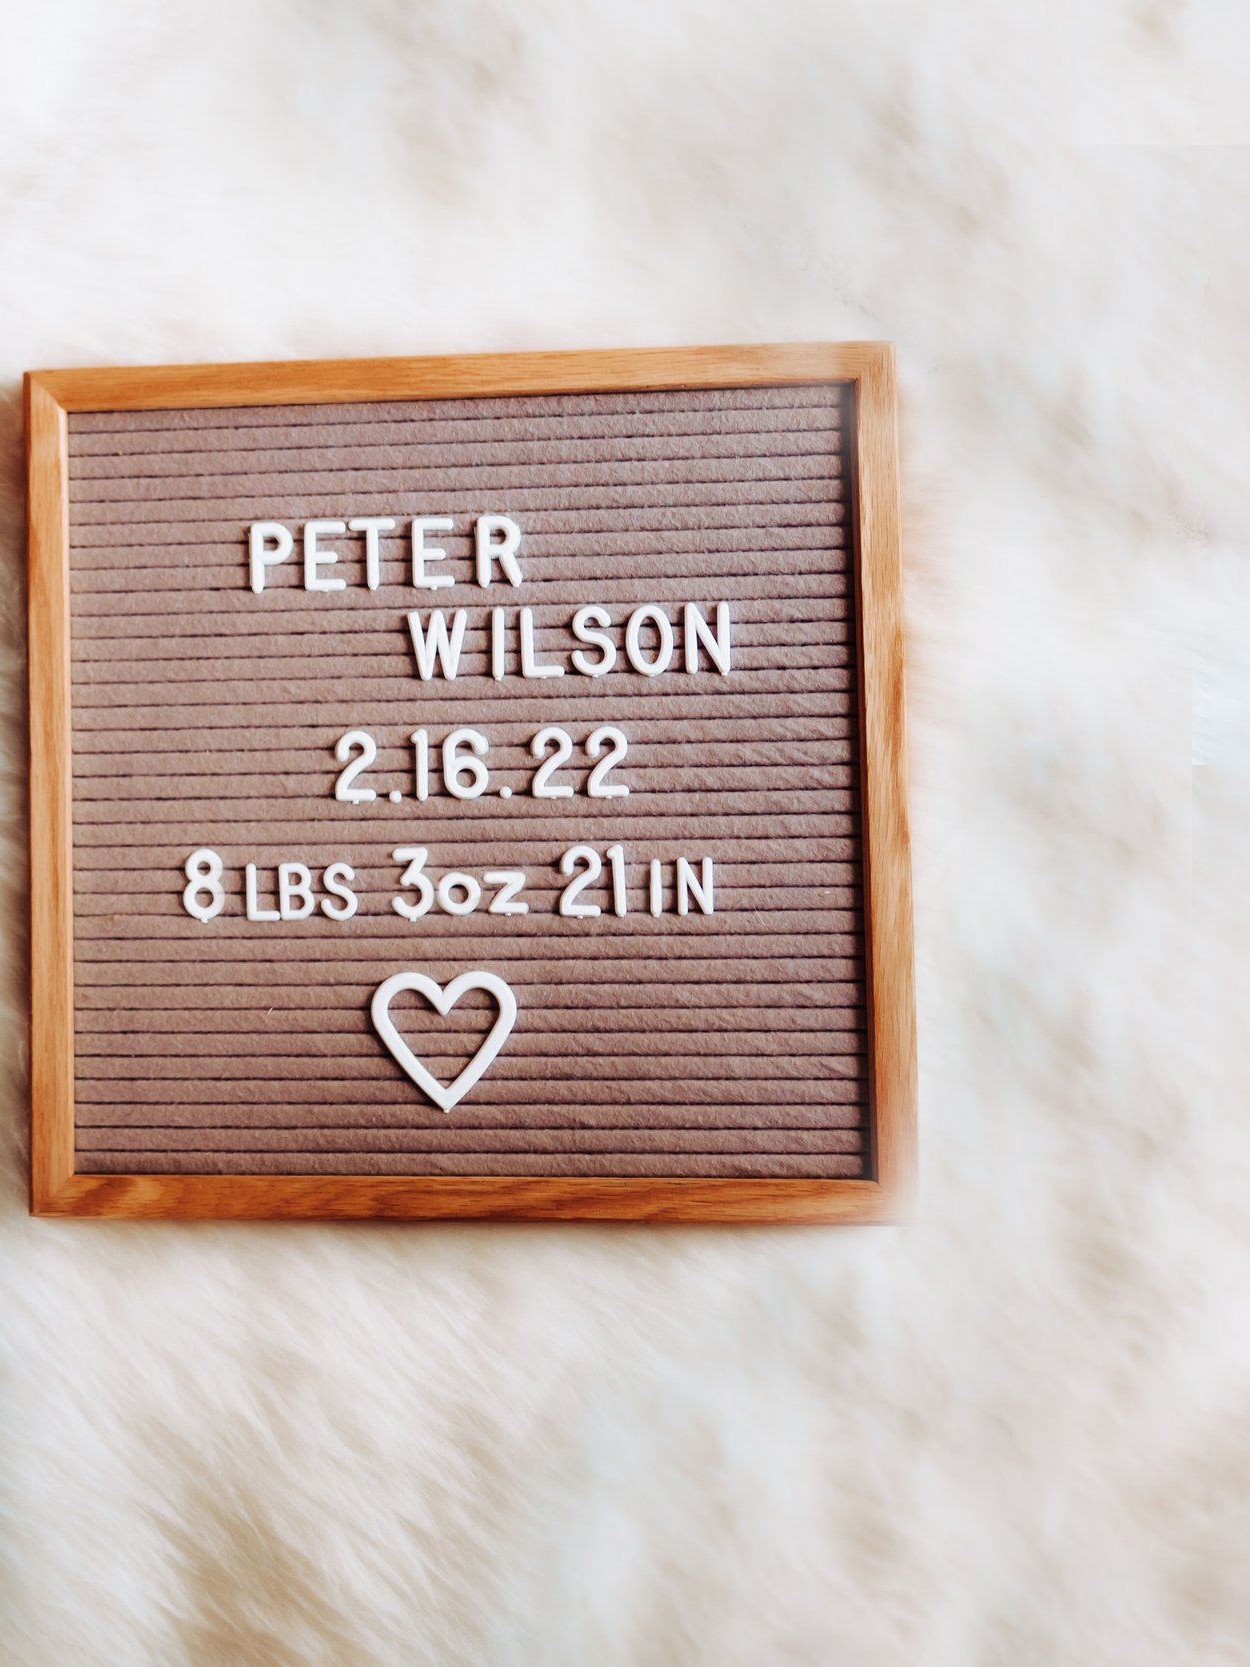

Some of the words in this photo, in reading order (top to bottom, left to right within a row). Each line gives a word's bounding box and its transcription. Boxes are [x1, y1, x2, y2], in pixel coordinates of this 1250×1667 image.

[249, 513, 524, 594] PETER
[407, 601, 732, 682] WILSON
[334, 726, 631, 804] 2.16.22
